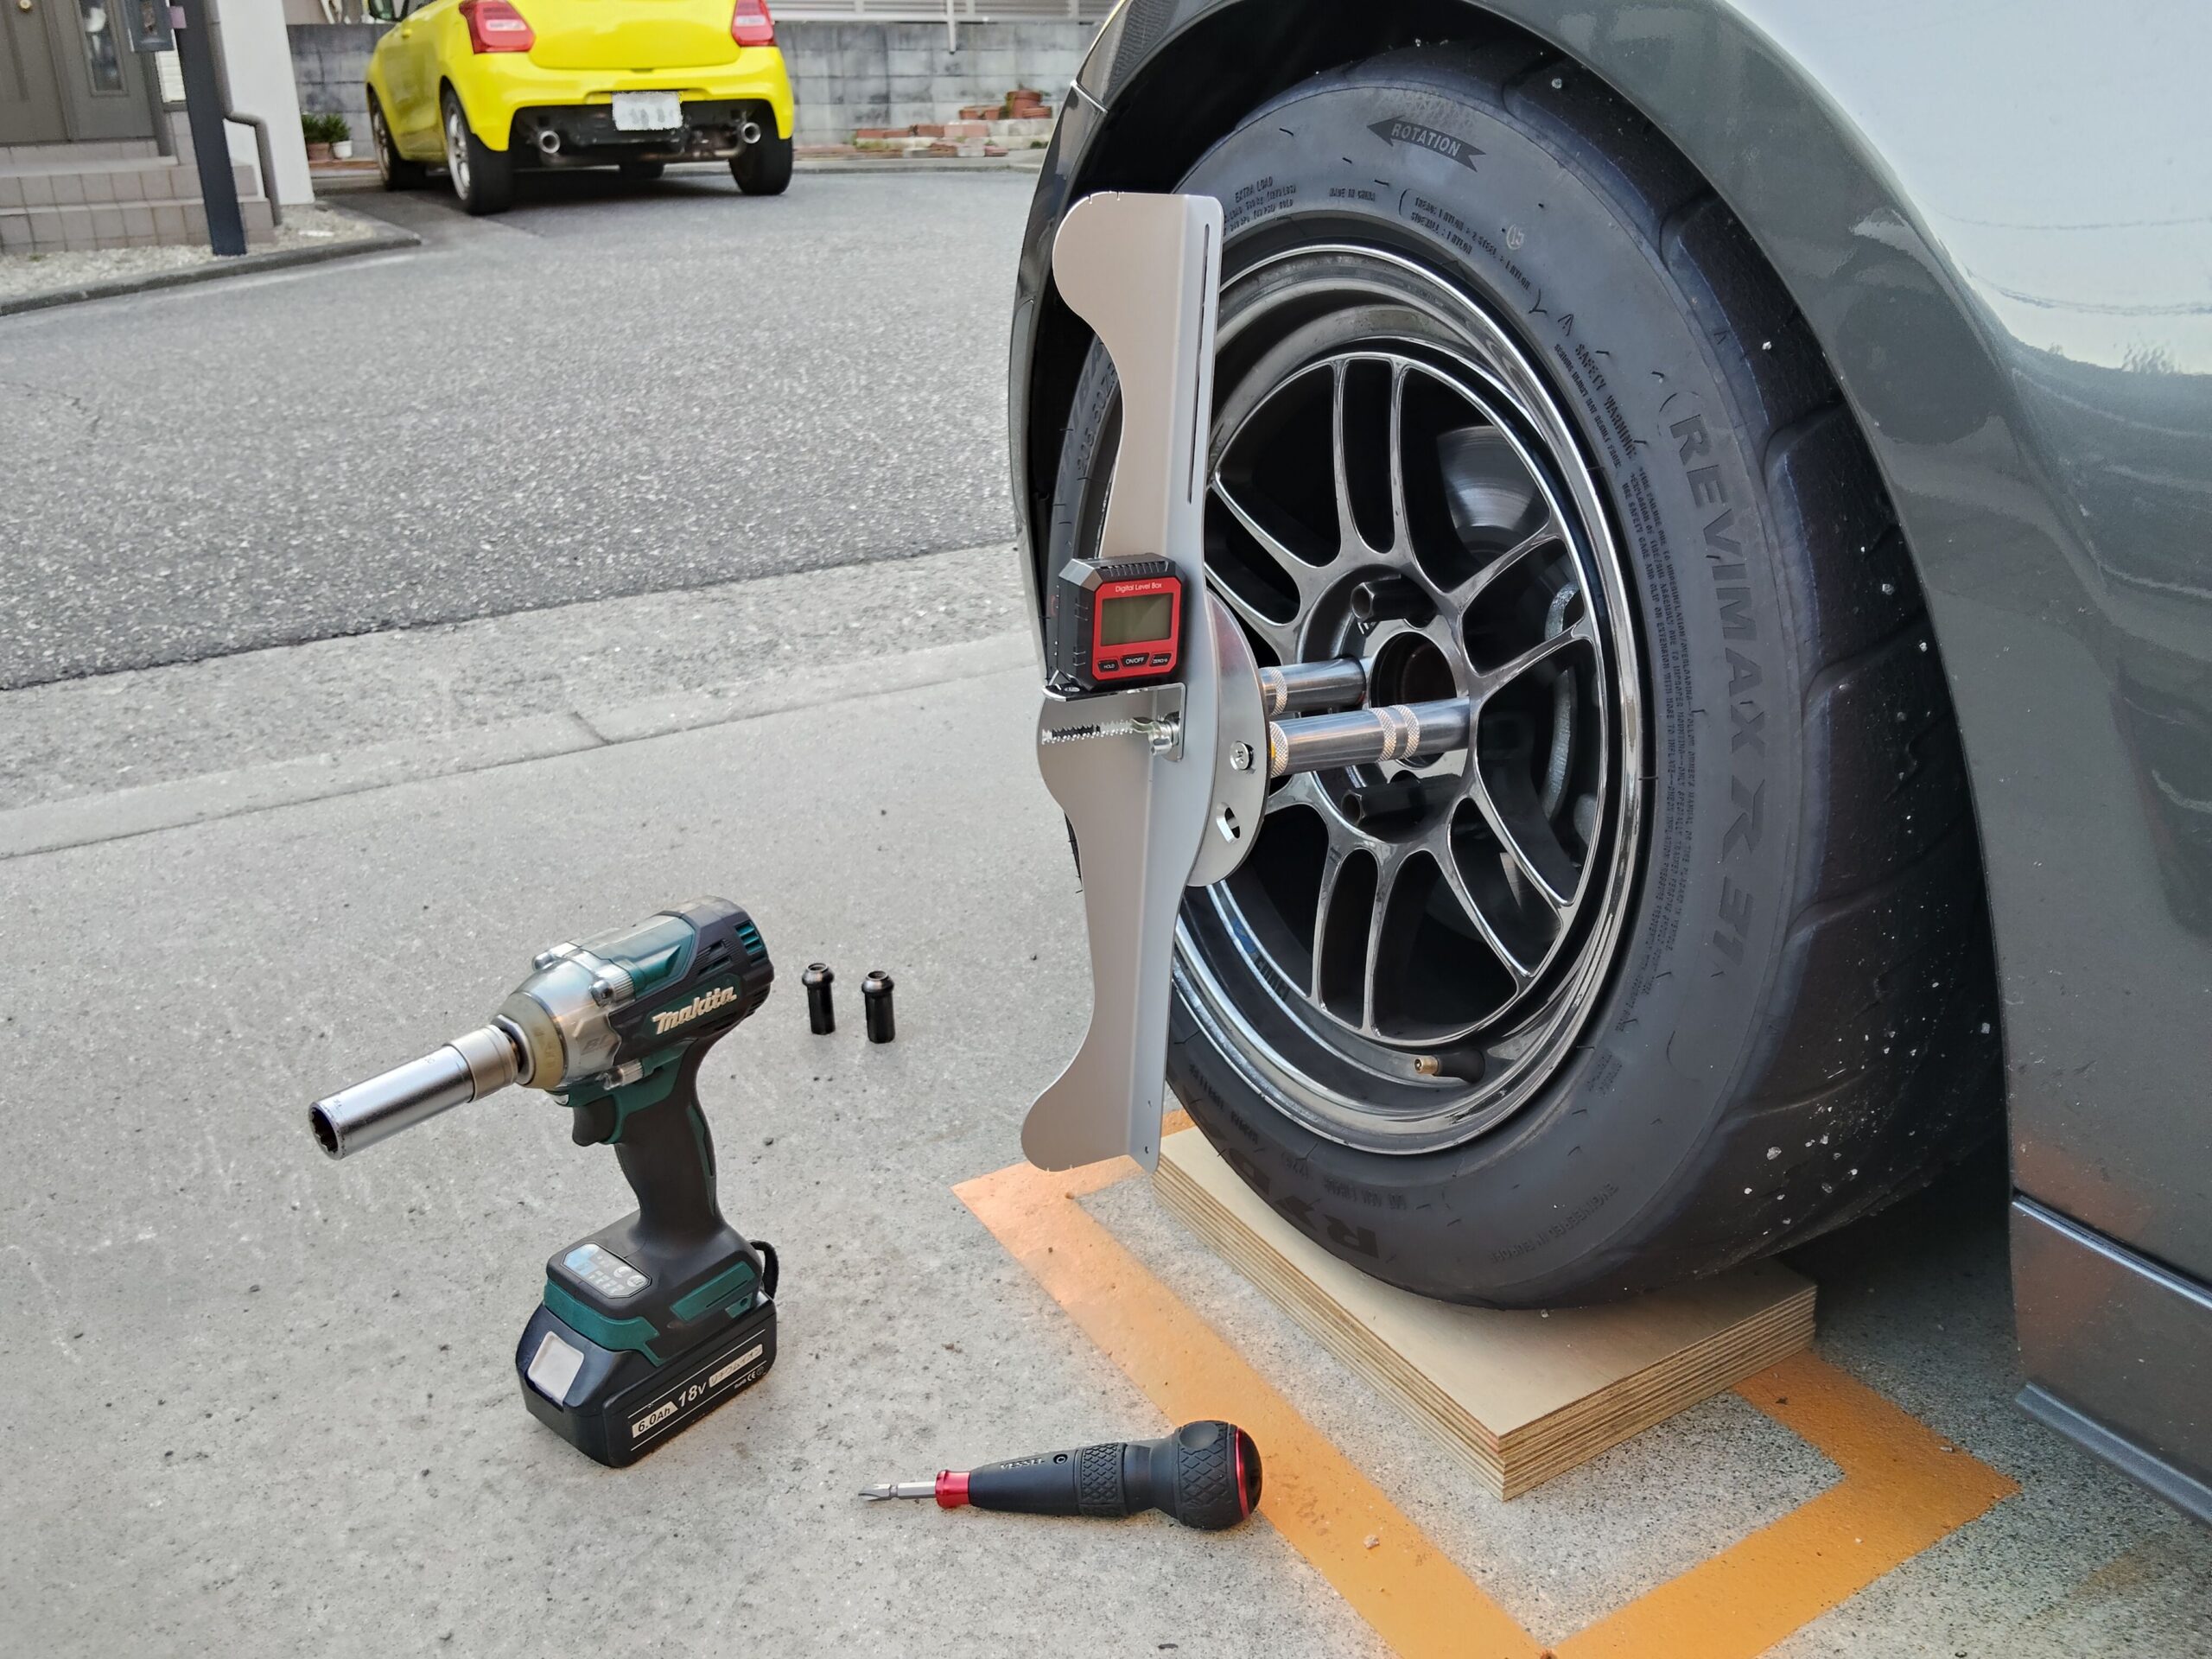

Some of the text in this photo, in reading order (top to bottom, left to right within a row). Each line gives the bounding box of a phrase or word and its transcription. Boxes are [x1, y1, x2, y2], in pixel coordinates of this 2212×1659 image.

[1391, 123, 1462, 157] ROTATION
[1574, 342, 1606, 391] SAFETY
[1669, 413, 1766, 753] REVIMAX
[638, 1408, 671, 1432] 6.0Ah
[1000, 1458, 1045, 1469] VESSEL
